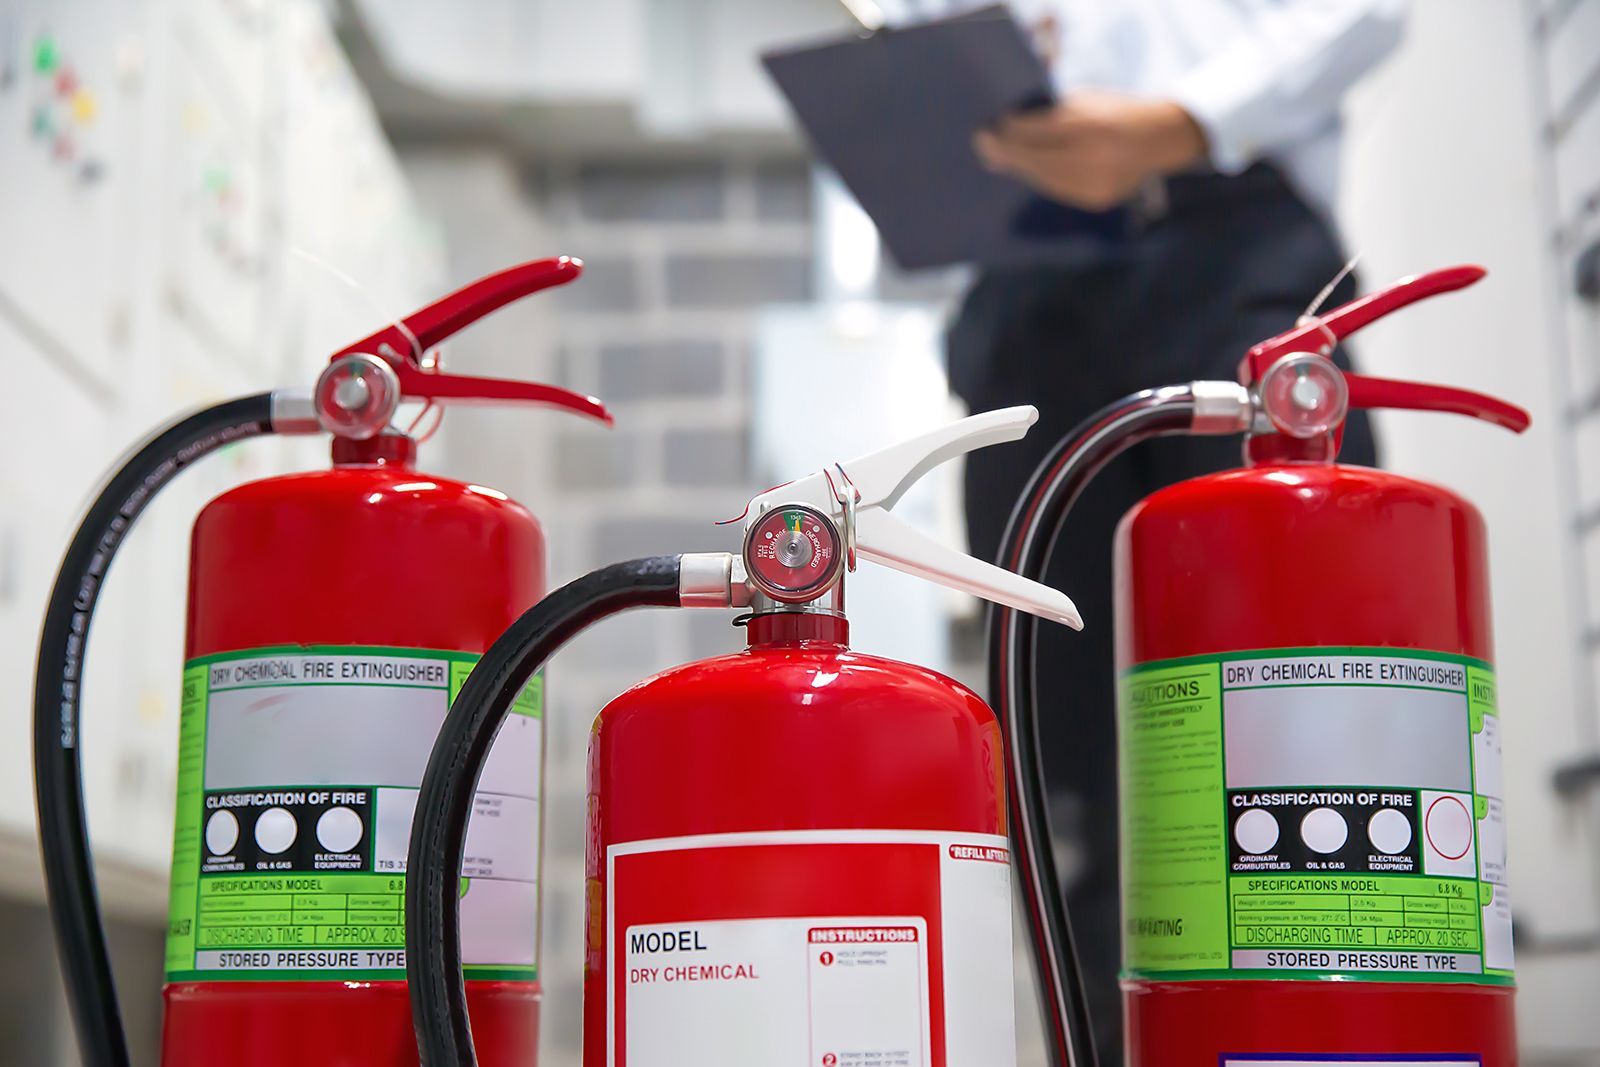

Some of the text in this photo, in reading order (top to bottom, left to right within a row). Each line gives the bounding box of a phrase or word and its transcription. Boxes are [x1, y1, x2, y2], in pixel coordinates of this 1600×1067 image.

[303, 662, 334, 679] FIRE
[341, 662, 444, 682] EXTINGUISHER
[1227, 663, 1465, 686] DRY CHEMICAL FIRE EXTINGUISHER
[206, 792, 367, 809] CLASSIFICATION OF FIRE
[1232, 793, 1413, 807] CLASSIFICATION OF FIRE
[256, 861, 268, 870] OIL
[276, 861, 292, 870] GAS
[314, 854, 362, 862] ELECTRICAL
[314, 861, 362, 870] EQUIPMENT
[378, 860, 394, 869] TIS
[1368, 854, 1413, 863] ELECTRICAL
[1233, 862, 1291, 871] COMBUSTIBLES
[1306, 862, 1345, 870] OIL & GAS
[1368, 863, 1413, 871] EQUIPMENT
[211, 879, 404, 892] SPECIFICATIONS MODEL 6.8
[1248, 879, 1463, 898] SPECIFICATIONS MODEL 6.8 Kg
[276, 928, 304, 943] TIME
[383, 927, 397, 943] 20
[631, 930, 707, 954] MODEL
[811, 929, 915, 942] INSTRUCTIONS
[1246, 928, 1364, 944] DISCHARGING TIME
[1437, 930, 1448, 946] 20
[220, 952, 405, 967] STORED PRESSURE TYPE
[1267, 953, 1457, 970] STORED PRESSURE TYPE
[631, 964, 760, 983] DRY CHEMICAL
